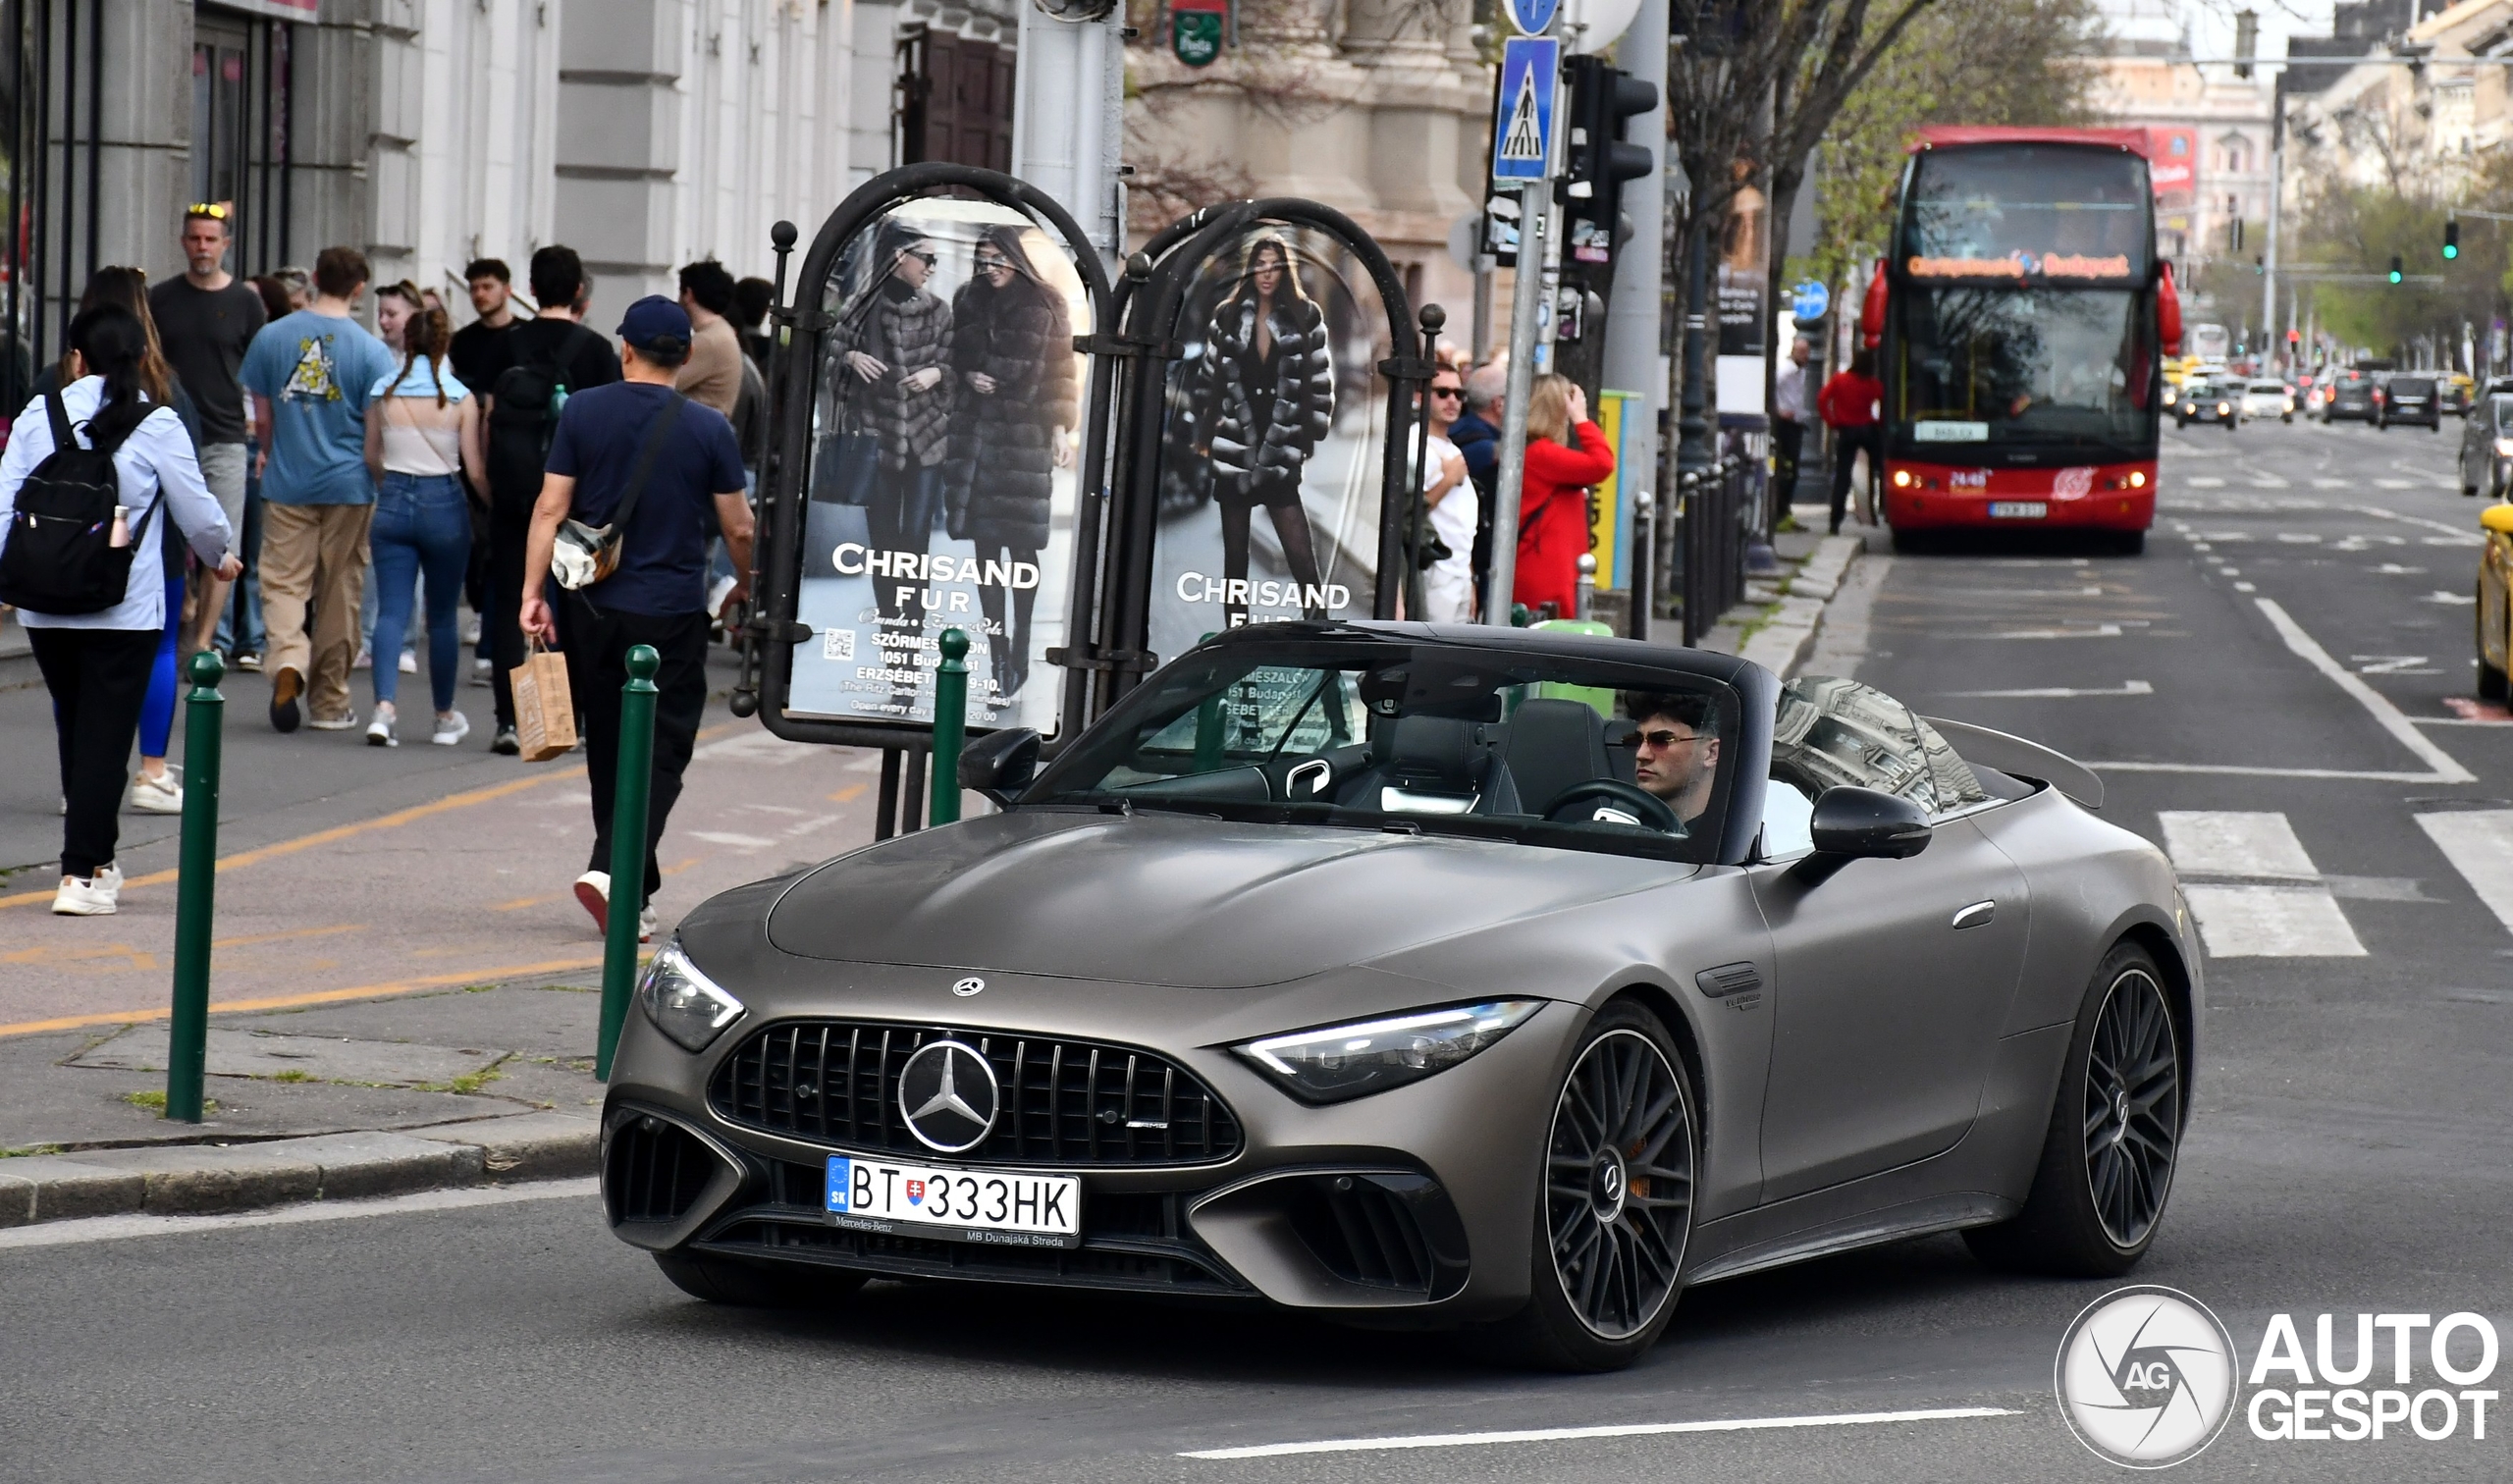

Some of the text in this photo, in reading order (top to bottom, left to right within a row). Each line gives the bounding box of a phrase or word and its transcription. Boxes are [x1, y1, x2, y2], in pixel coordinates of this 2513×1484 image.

[832, 543, 1040, 589] CHRISAND
[895, 586, 970, 612] FUR
[1177, 571, 1351, 610] CHRISAND
[858, 607, 909, 627] Bunda
[871, 630, 988, 655] SZŐRMESON
[879, 651, 980, 671] 1051 Budst
[856, 665, 933, 685] ERZSÉBET
[866, 684, 883, 694] Ritz
[887, 686, 922, 698] Carlton
[850, 700, 878, 713] Open
[881, 704, 907, 715] every
[831, 1191, 846, 1205] SK
[853, 1165, 1068, 1228] BT 333HK
[835, 1216, 893, 1234] Mercedes-Benz
[967, 1232, 983, 1243] MB
[1033, 1236, 1064, 1247] Streda
